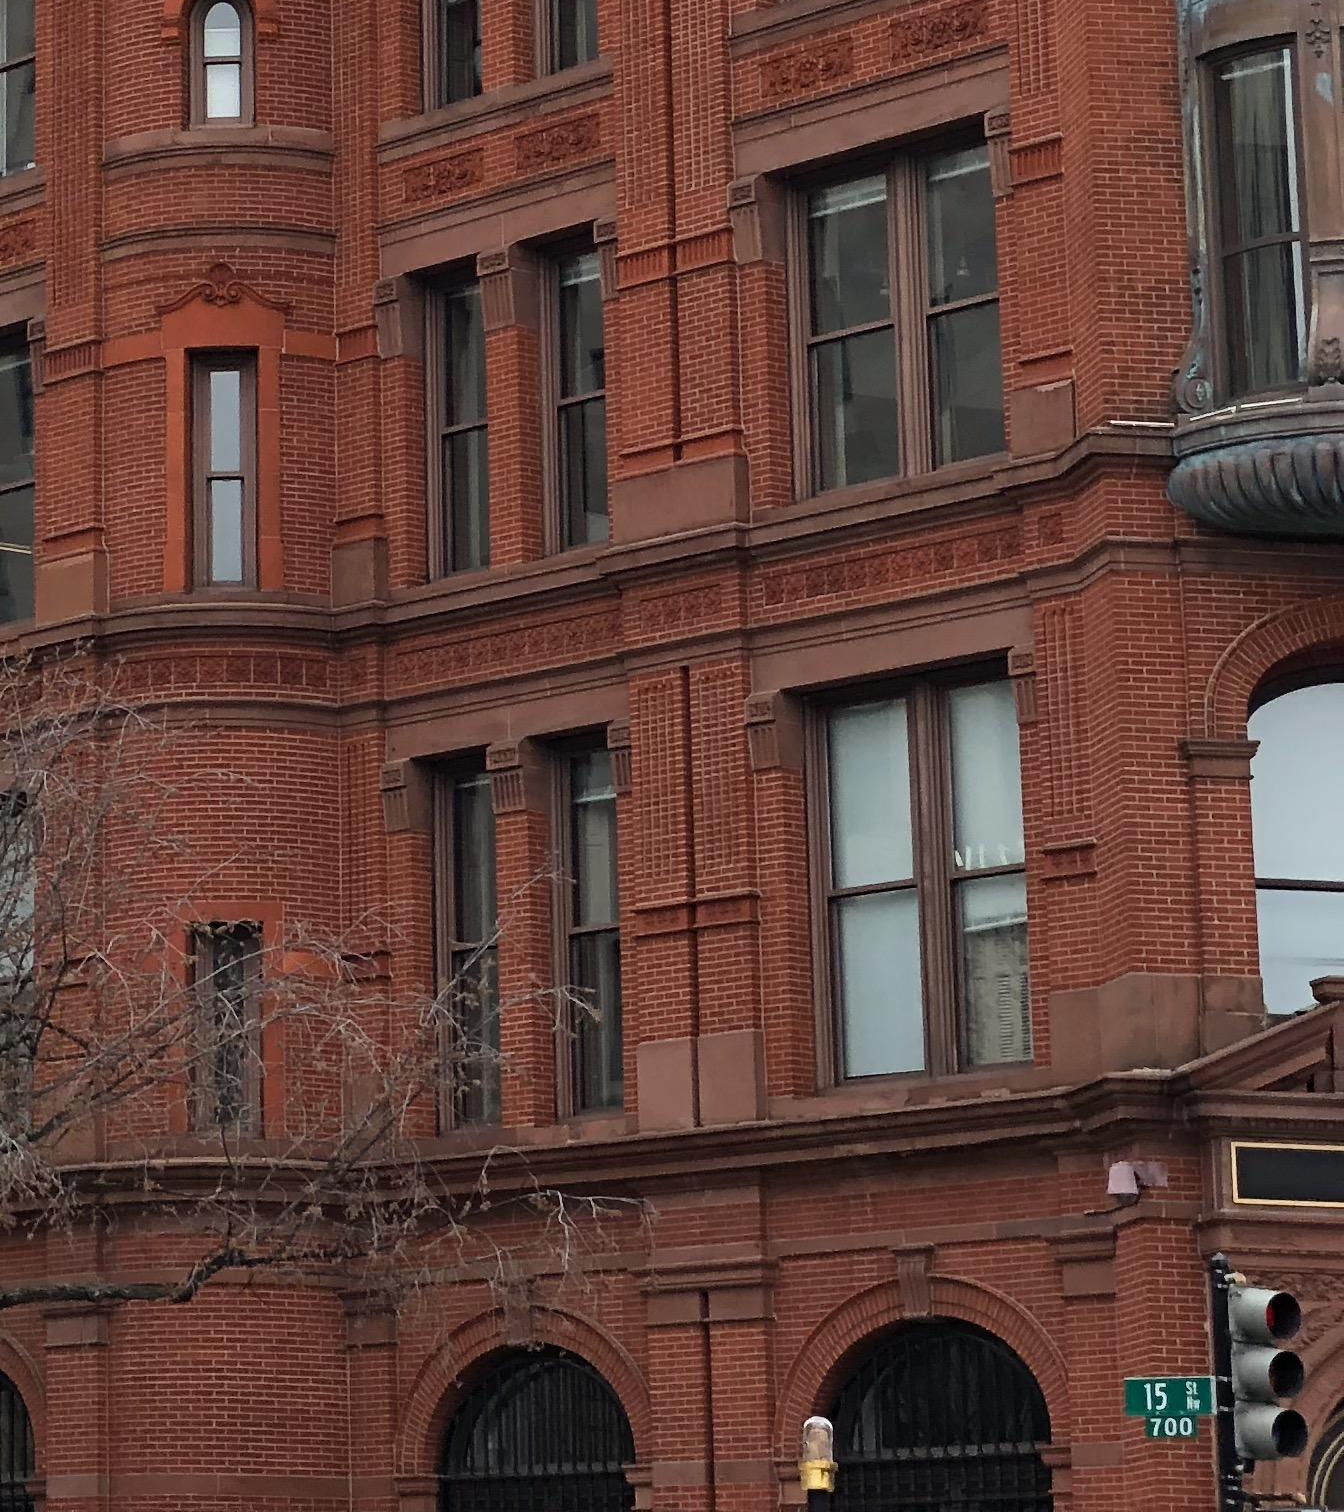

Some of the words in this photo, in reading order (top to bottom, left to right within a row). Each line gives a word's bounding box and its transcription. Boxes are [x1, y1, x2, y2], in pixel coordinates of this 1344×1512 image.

[1144, 1383, 1167, 1410] 15
[1185, 1381, 1198, 1395] St
[1150, 1417, 1192, 1437] 700
